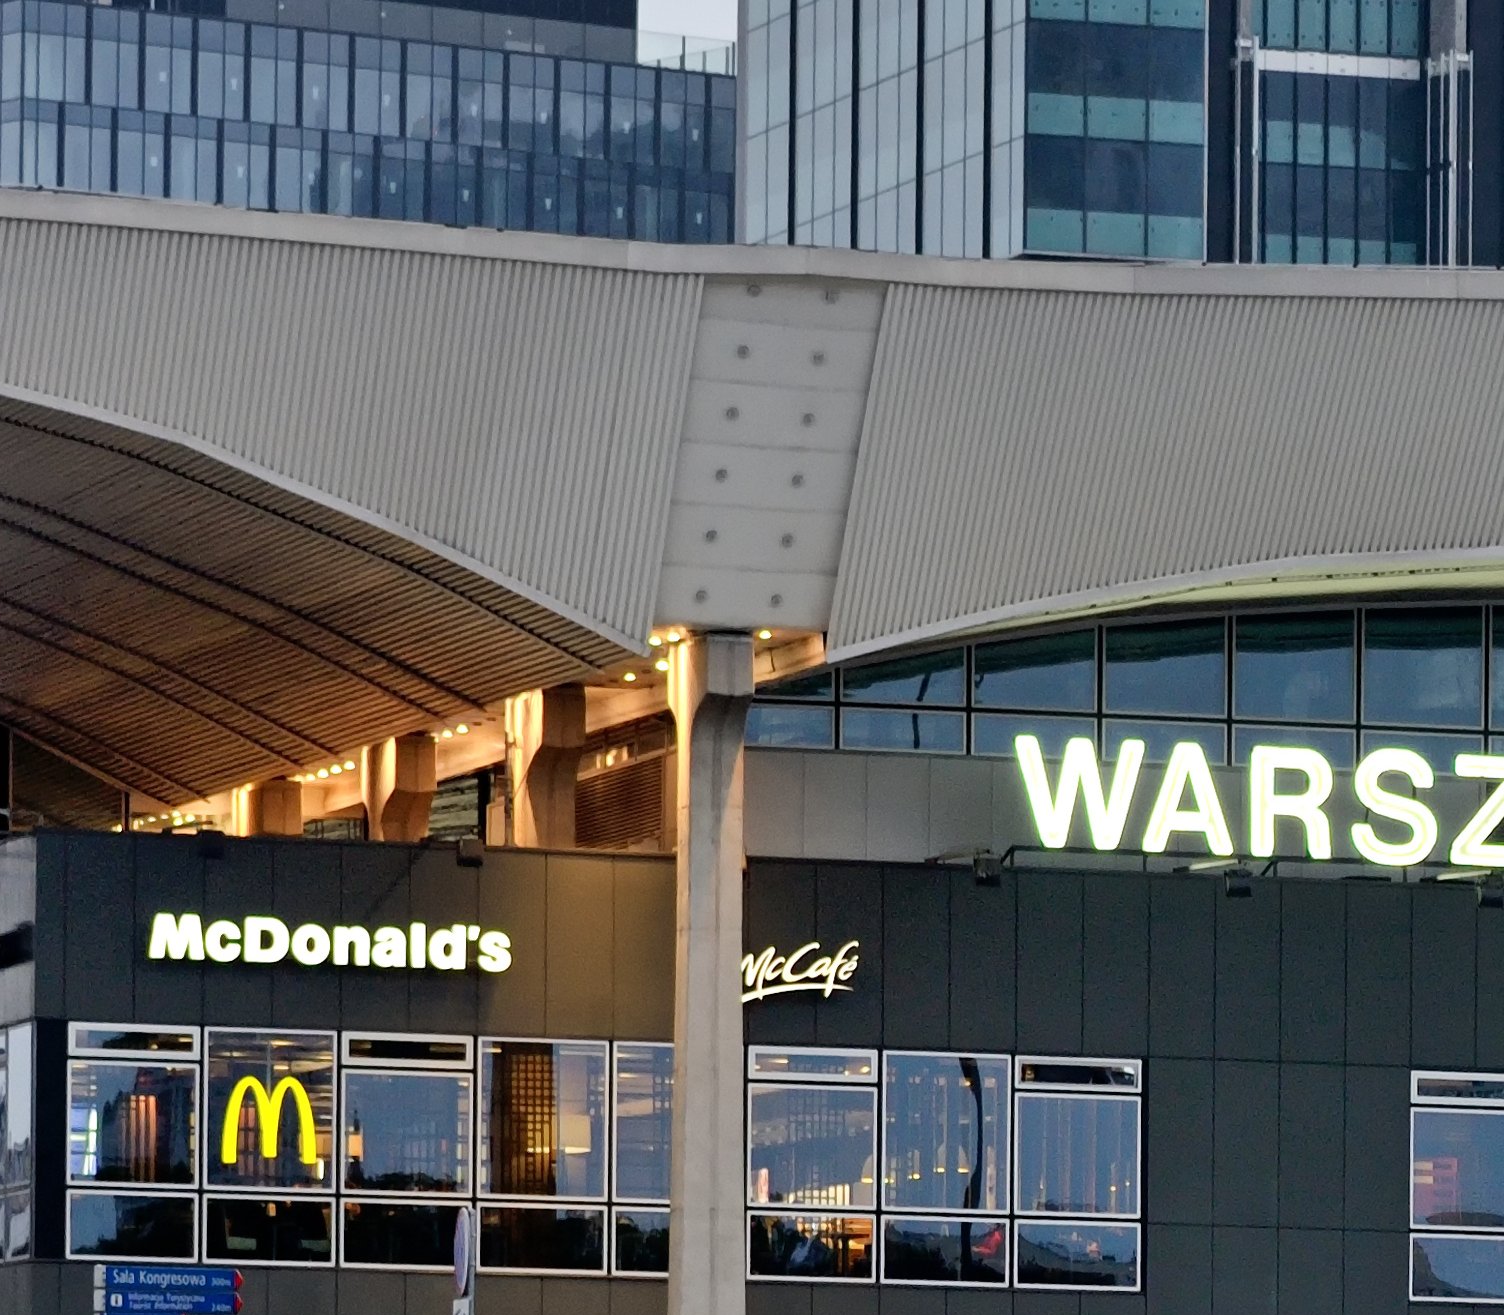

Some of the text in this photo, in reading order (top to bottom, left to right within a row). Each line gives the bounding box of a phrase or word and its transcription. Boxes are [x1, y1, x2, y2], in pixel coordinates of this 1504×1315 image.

[149, 912, 512, 973] McDonald's
[741, 940, 859, 1001] McCafé
[113, 1269, 135, 1284] Sala
[139, 1270, 207, 1289] Kongresowa
